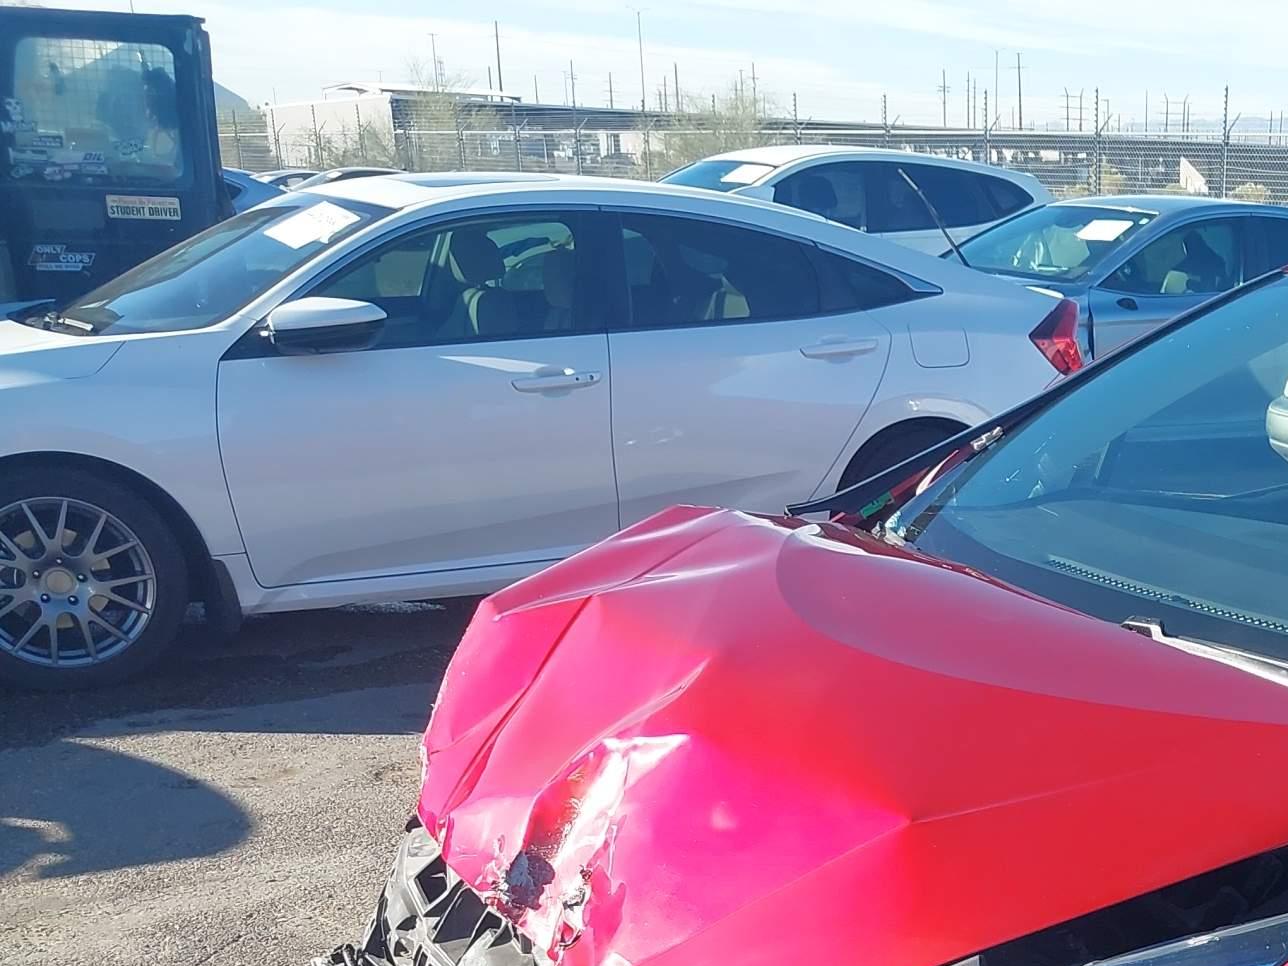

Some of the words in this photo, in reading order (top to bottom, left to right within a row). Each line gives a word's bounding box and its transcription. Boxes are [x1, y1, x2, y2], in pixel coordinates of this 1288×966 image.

[110, 205, 146, 217] STUDENT
[148, 206, 180, 217] DRIVER
[36, 246, 62, 254] ONLY
[59, 254, 90, 263] COPS
